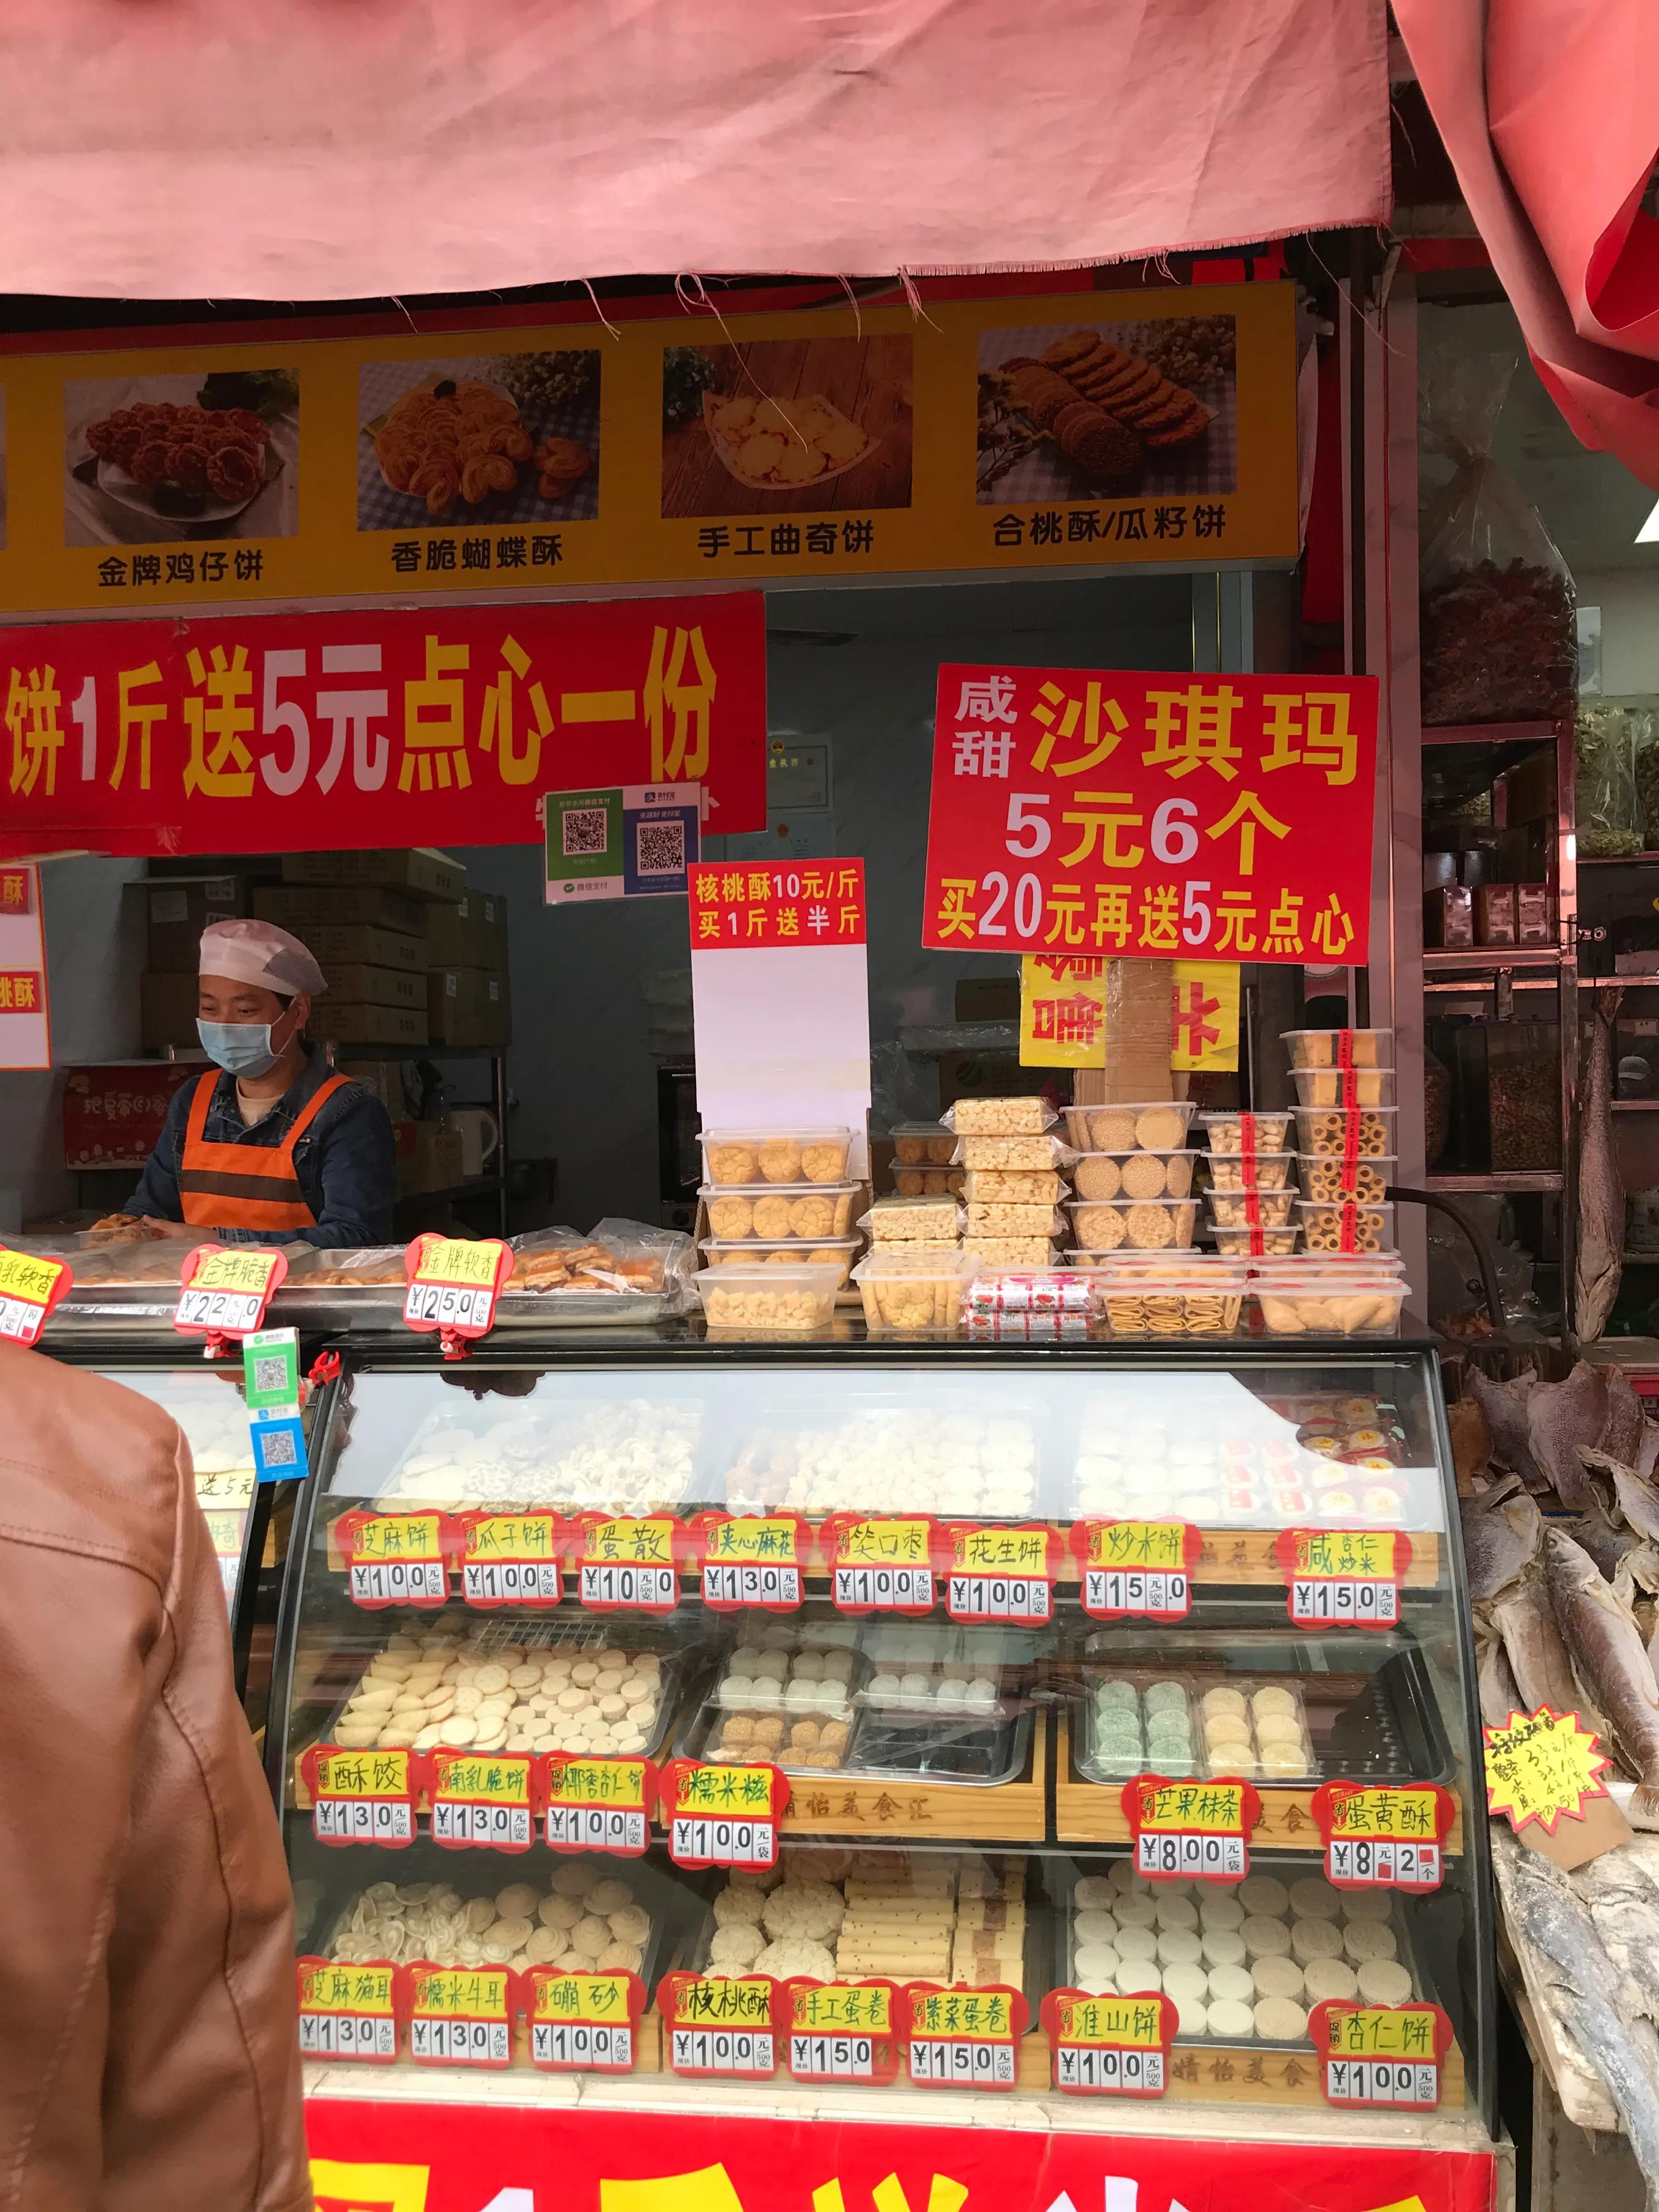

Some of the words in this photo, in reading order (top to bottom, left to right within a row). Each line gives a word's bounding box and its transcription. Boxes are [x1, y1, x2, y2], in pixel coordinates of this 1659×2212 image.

[697, 520, 873, 559] 手工曲奇饼
[992, 504, 1226, 547] 合桃酥/瓜籽饼
[98, 549, 263, 587] 金牌鸡仔饼
[391, 535, 563, 573] 香脆蝴蝶酥
[5, 625, 717, 799] 饼1斤送5元点心一份
[1030, 680, 1358, 786] 沙琪玛
[1005, 790, 1292, 876] 5元6个
[577, 882, 608, 891] 微信支付
[696, 868, 859, 904] 核桃酥10元/斤
[699, 905, 860, 939] 买1斤送半斤
[938, 871, 1354, 955] 买20元再送5元点心
[364, 1521, 429, 1558] 芝麻饼
[478, 1523, 549, 1555] 瓜子饼
[602, 1526, 670, 1561] 蛋散
[720, 1523, 794, 1558] 夹心麻花
[850, 1525, 922, 1561] 笑口枣
[969, 1535, 1042, 1569] 花生饼
[335, 1757, 401, 1794] 酥饺
[689, 1770, 769, 1808] 糯米糍
[1345, 1794, 1431, 1836] 蛋黄酥
[689, 1981, 769, 2023] 核桃酥
[806, 1990, 886, 2026] 手工蛋卷
[927, 1996, 1008, 2033] 紫菜蛋卷
[1347, 2011, 1430, 2055] 杏仁饼
